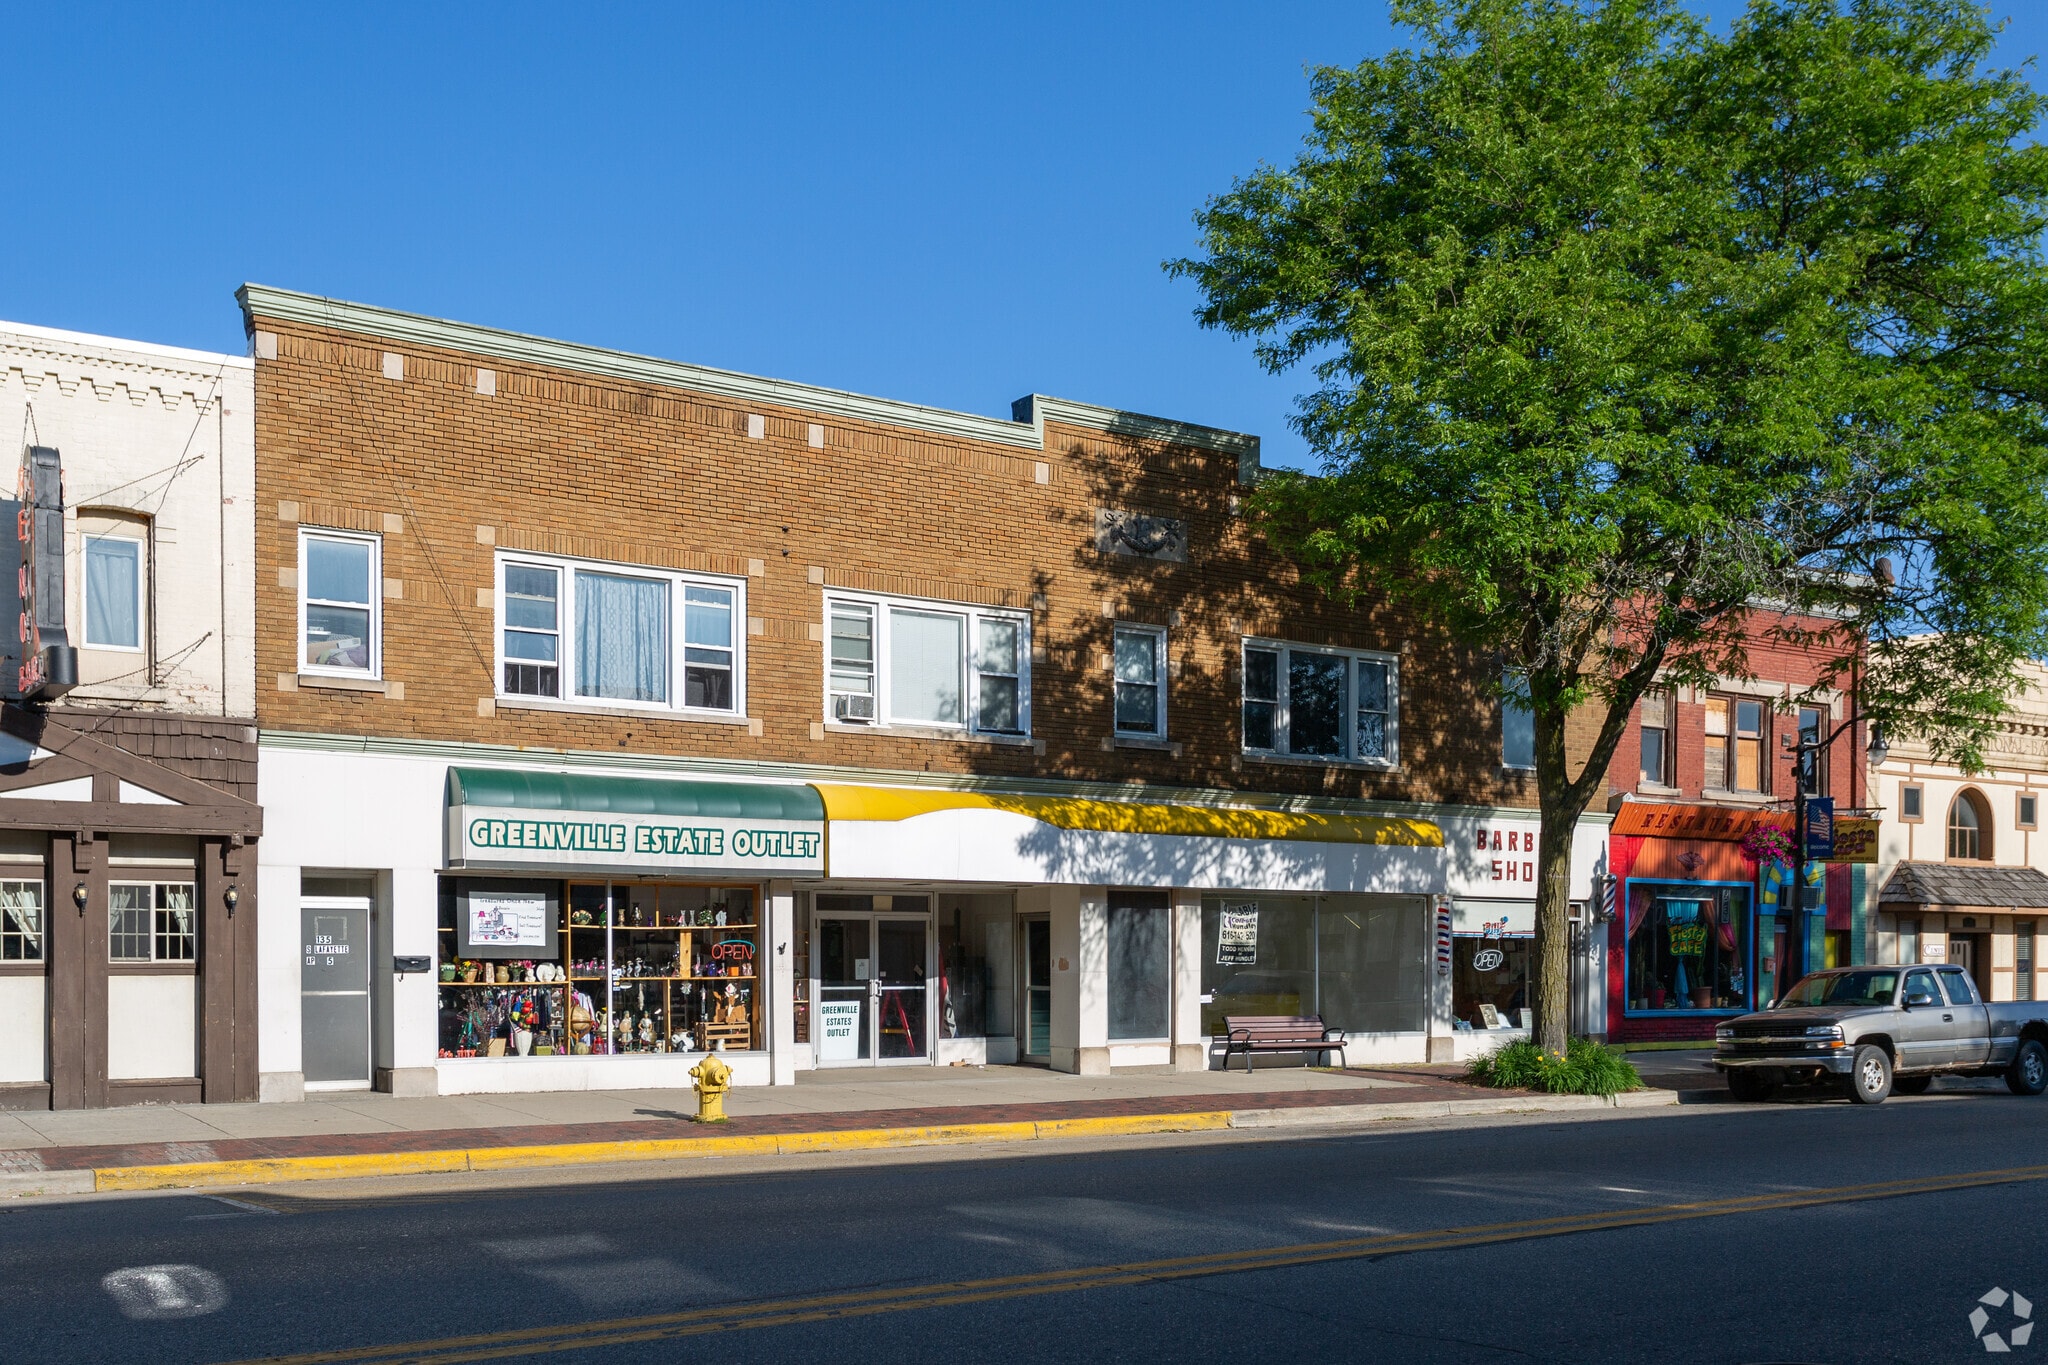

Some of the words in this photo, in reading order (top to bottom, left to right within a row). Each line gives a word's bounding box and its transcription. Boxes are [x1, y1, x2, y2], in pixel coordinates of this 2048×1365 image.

[469, 818, 626, 852] GREENVILLE
[635, 825, 724, 855] ESTATE
[732, 829, 821, 858] OUTLET
[1476, 829, 1534, 853] BARB
[1833, 829, 1875, 844] iesta
[1491, 860, 1533, 882] SHO
[316, 935, 332, 944] 135
[1668, 924, 1706, 942] Fiesta
[306, 945, 311, 954] S
[314, 945, 349, 954] LAFAYETTE
[711, 944, 753, 960] OPEN
[1671, 940, 1703, 954] CAFE
[327, 957, 333, 965] 5
[1474, 954, 1501, 967] OPEN
[822, 1005, 857, 1014] GREENVILLE
[826, 1017, 852, 1026] ESTATES
[827, 1028, 850, 1037] OUTLET
